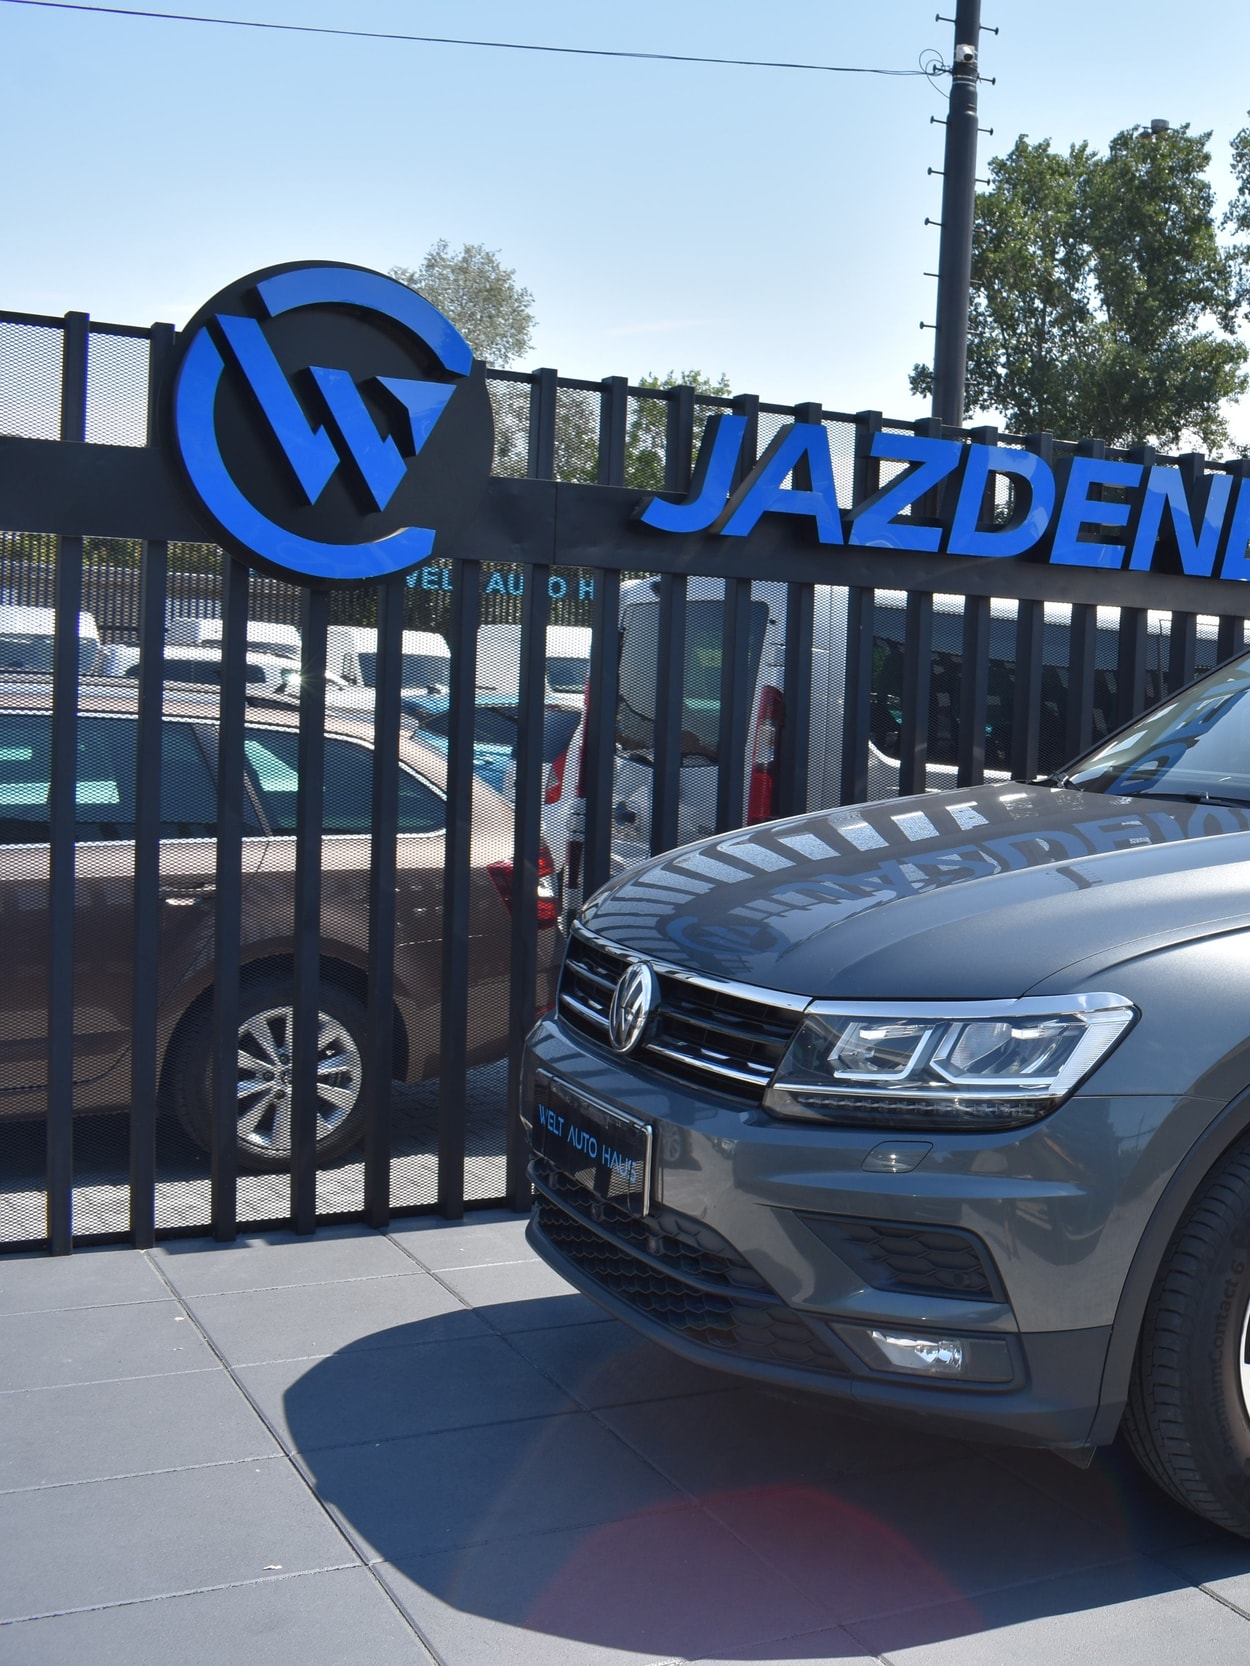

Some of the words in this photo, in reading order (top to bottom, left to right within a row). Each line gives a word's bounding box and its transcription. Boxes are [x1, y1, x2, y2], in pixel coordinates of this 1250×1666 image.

[486, 572, 567, 598] AUO
[538, 1104, 565, 1137] WELT
[567, 1125, 598, 1158] AUTO
